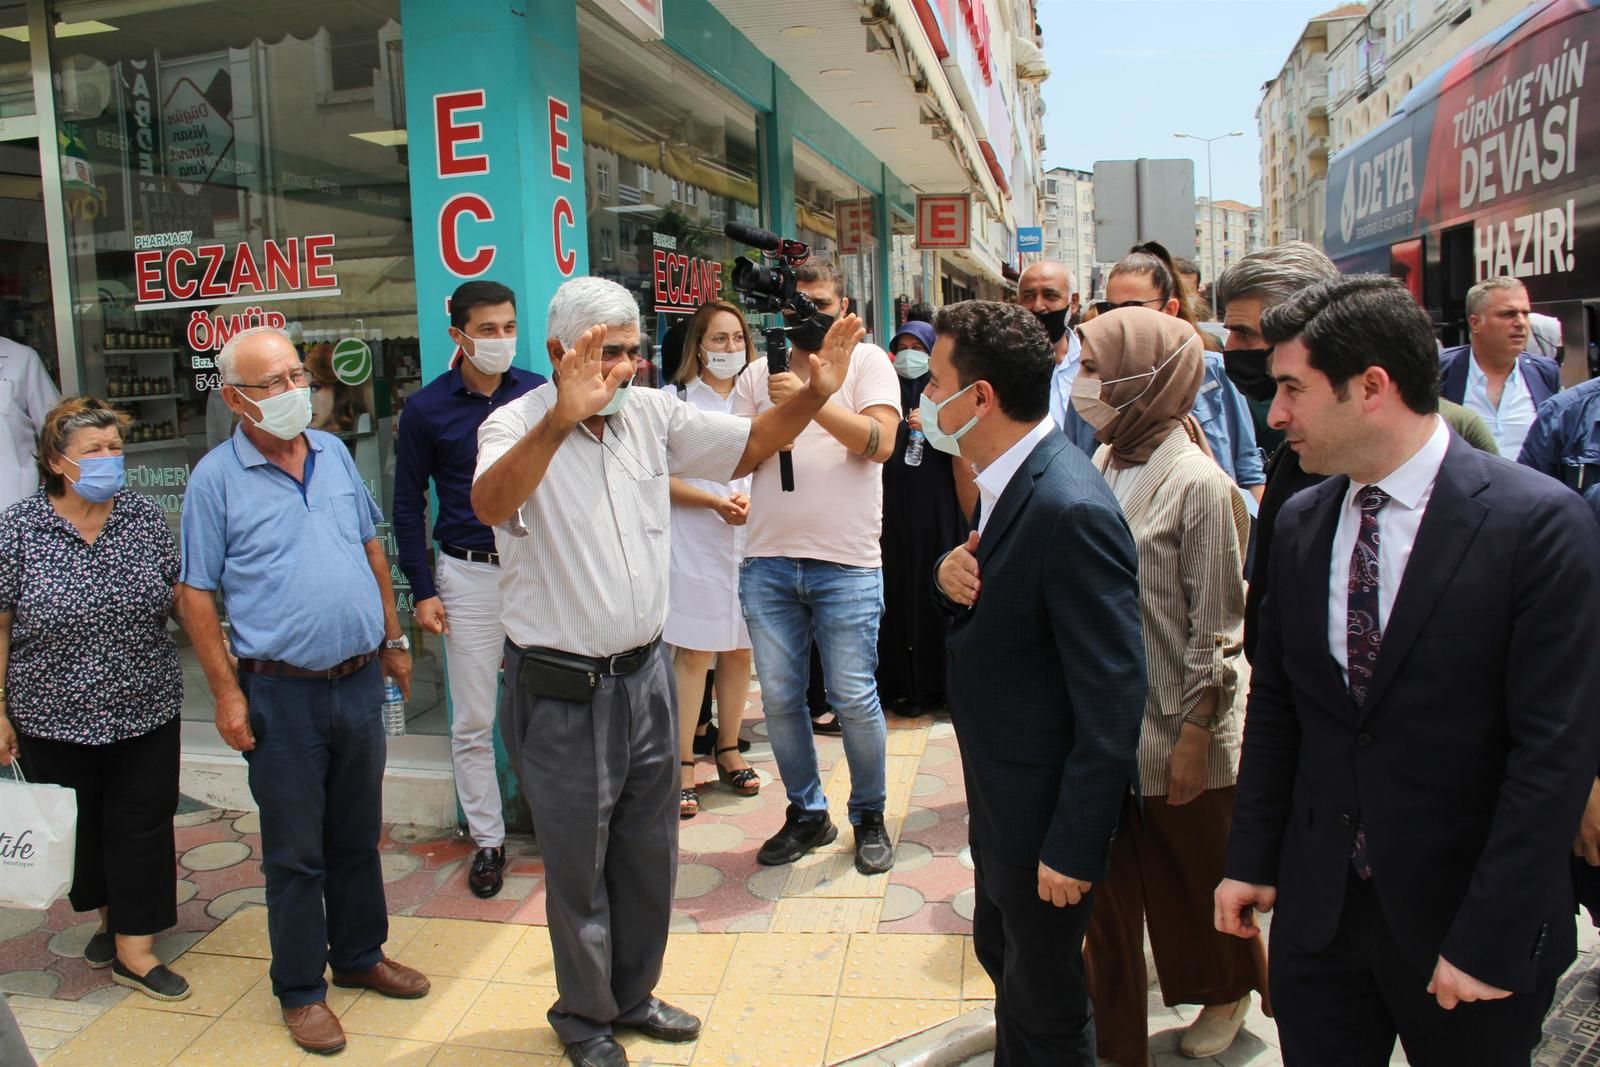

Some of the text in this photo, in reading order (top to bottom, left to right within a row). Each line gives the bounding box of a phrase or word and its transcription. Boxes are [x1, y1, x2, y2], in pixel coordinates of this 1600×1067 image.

[1453, 38, 1589, 149] TÜRKİYE'NİN
[1356, 136, 1414, 219] DEVA
[1460, 96, 1579, 209] DEVASI
[135, 231, 193, 249] PHARMACY
[931, 205, 955, 238] E
[1474, 199, 1575, 283] HAZIR!
[135, 234, 338, 302] ECZANE
[653, 249, 723, 306] ECZANE
[192, 356, 214, 369] Ecz.
